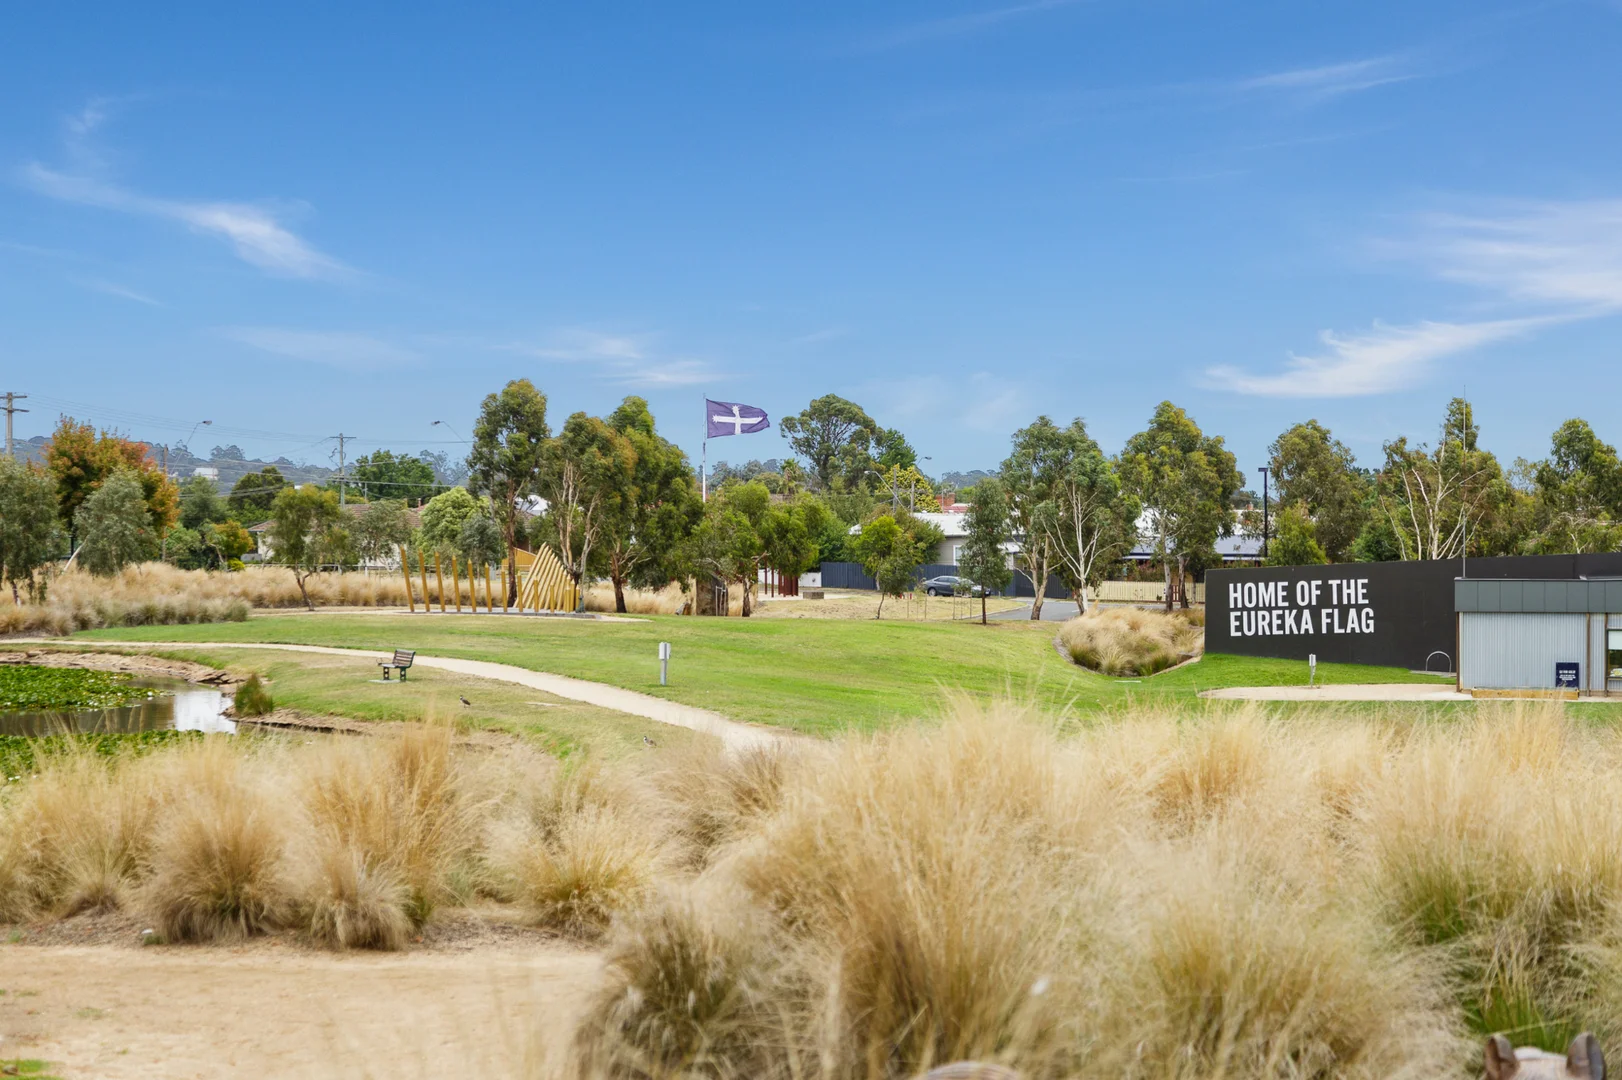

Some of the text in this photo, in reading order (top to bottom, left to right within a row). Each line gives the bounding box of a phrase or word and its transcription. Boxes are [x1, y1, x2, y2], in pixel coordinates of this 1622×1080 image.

[1229, 579, 1369, 608] HOME OF THE
[1230, 608, 1374, 636] EUREKA FLAG
